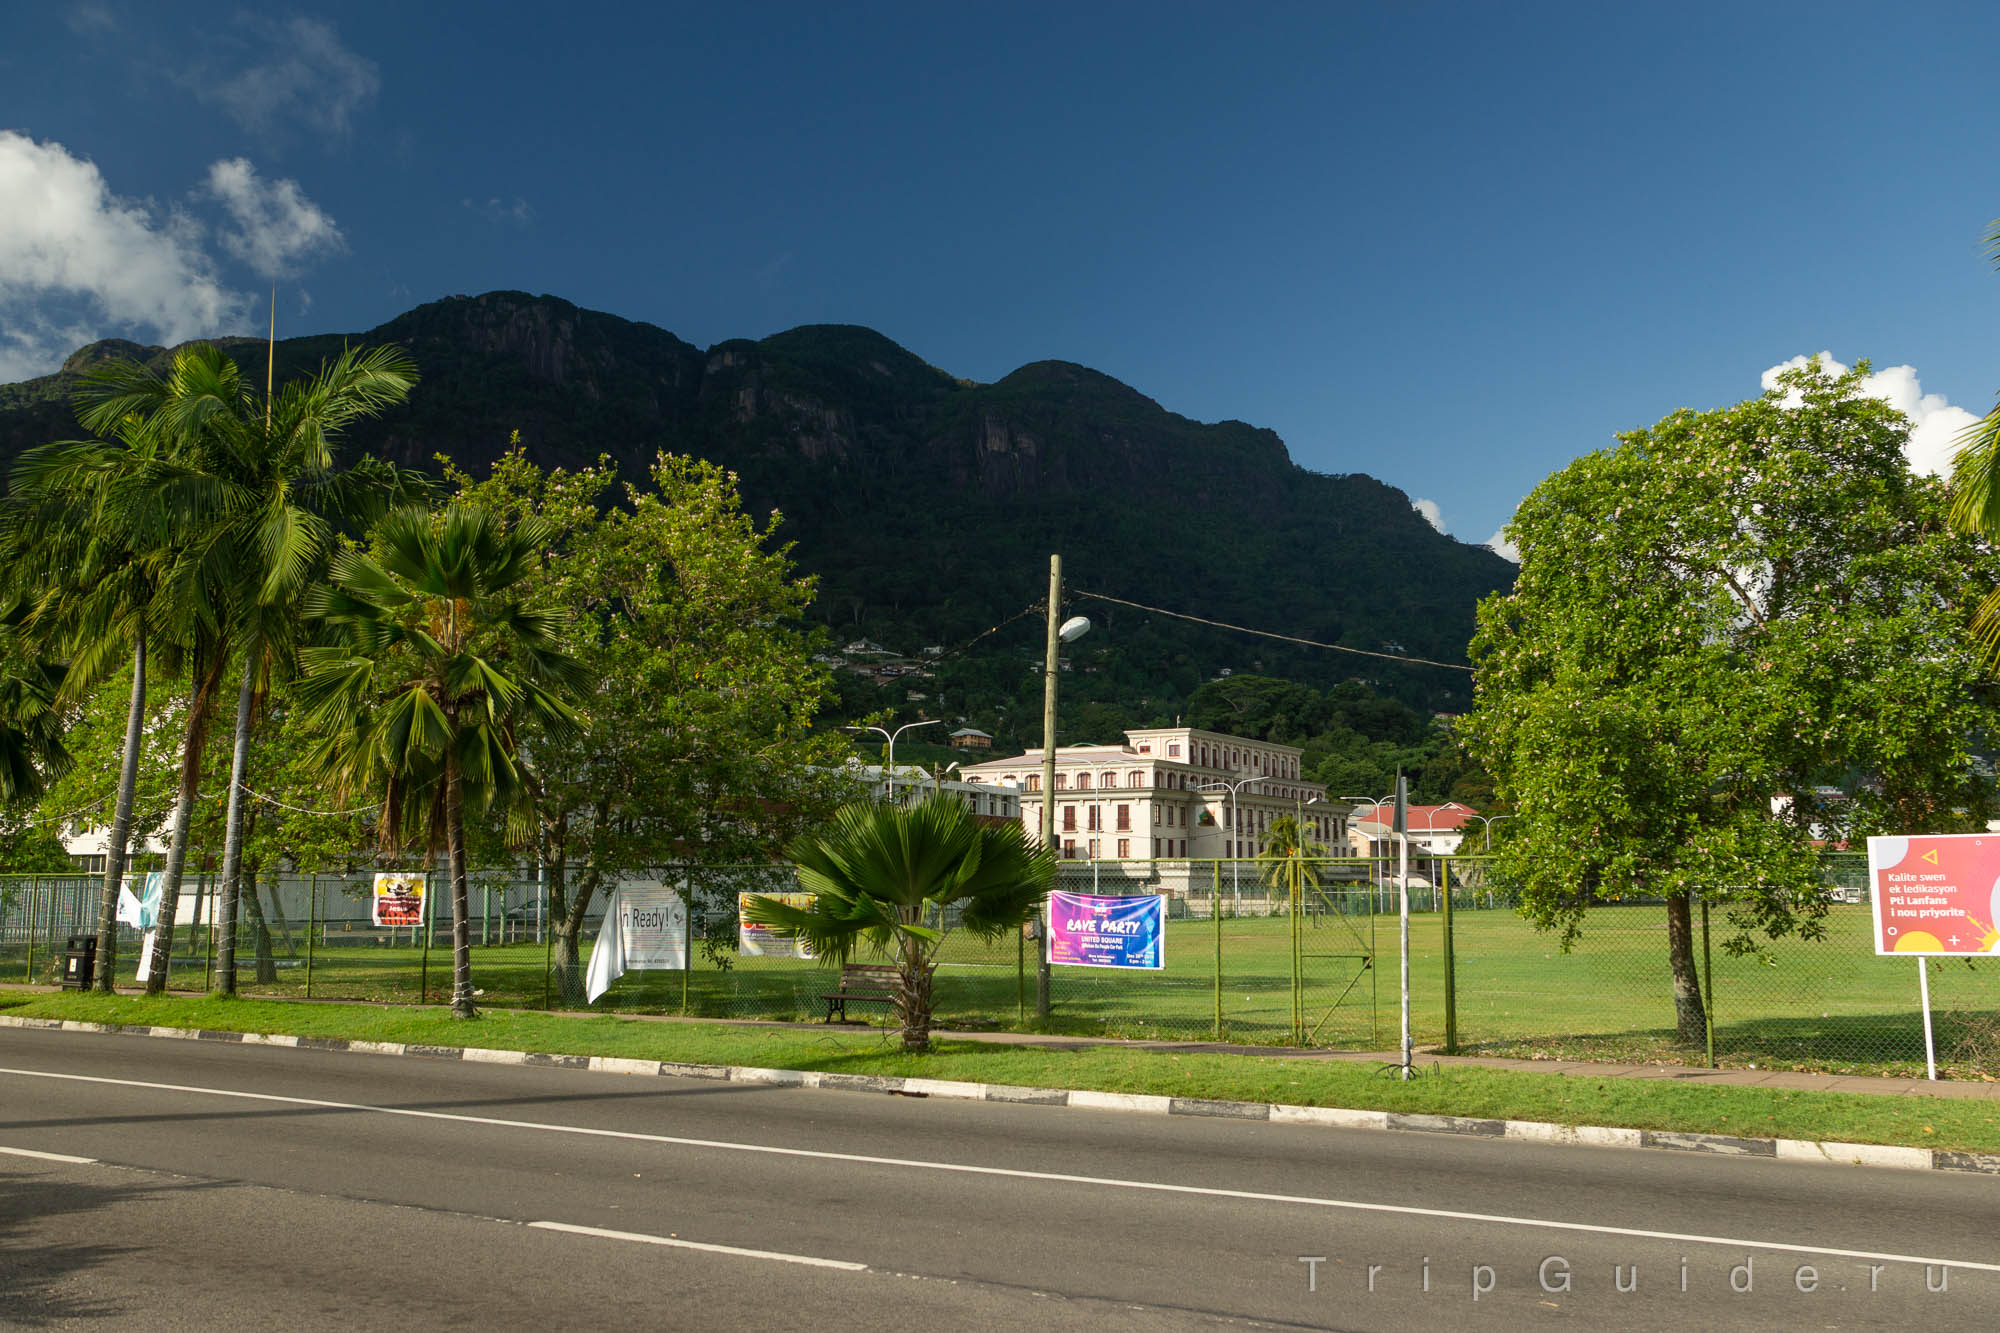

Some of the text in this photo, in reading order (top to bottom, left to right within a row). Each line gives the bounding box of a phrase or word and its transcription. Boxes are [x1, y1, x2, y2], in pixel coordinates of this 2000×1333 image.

[1888, 873, 1946, 882] Kalite swen
[1889, 885, 1957, 895] ek ledikasyon
[1890, 896, 1948, 905] Pti Lanfans
[1891, 907, 1965, 919] i nou priyorite
[633, 907, 669, 932] Ready!
[1067, 919, 1141, 934] RAVE PARTY
[1101, 936, 1124, 945] SQUARE
